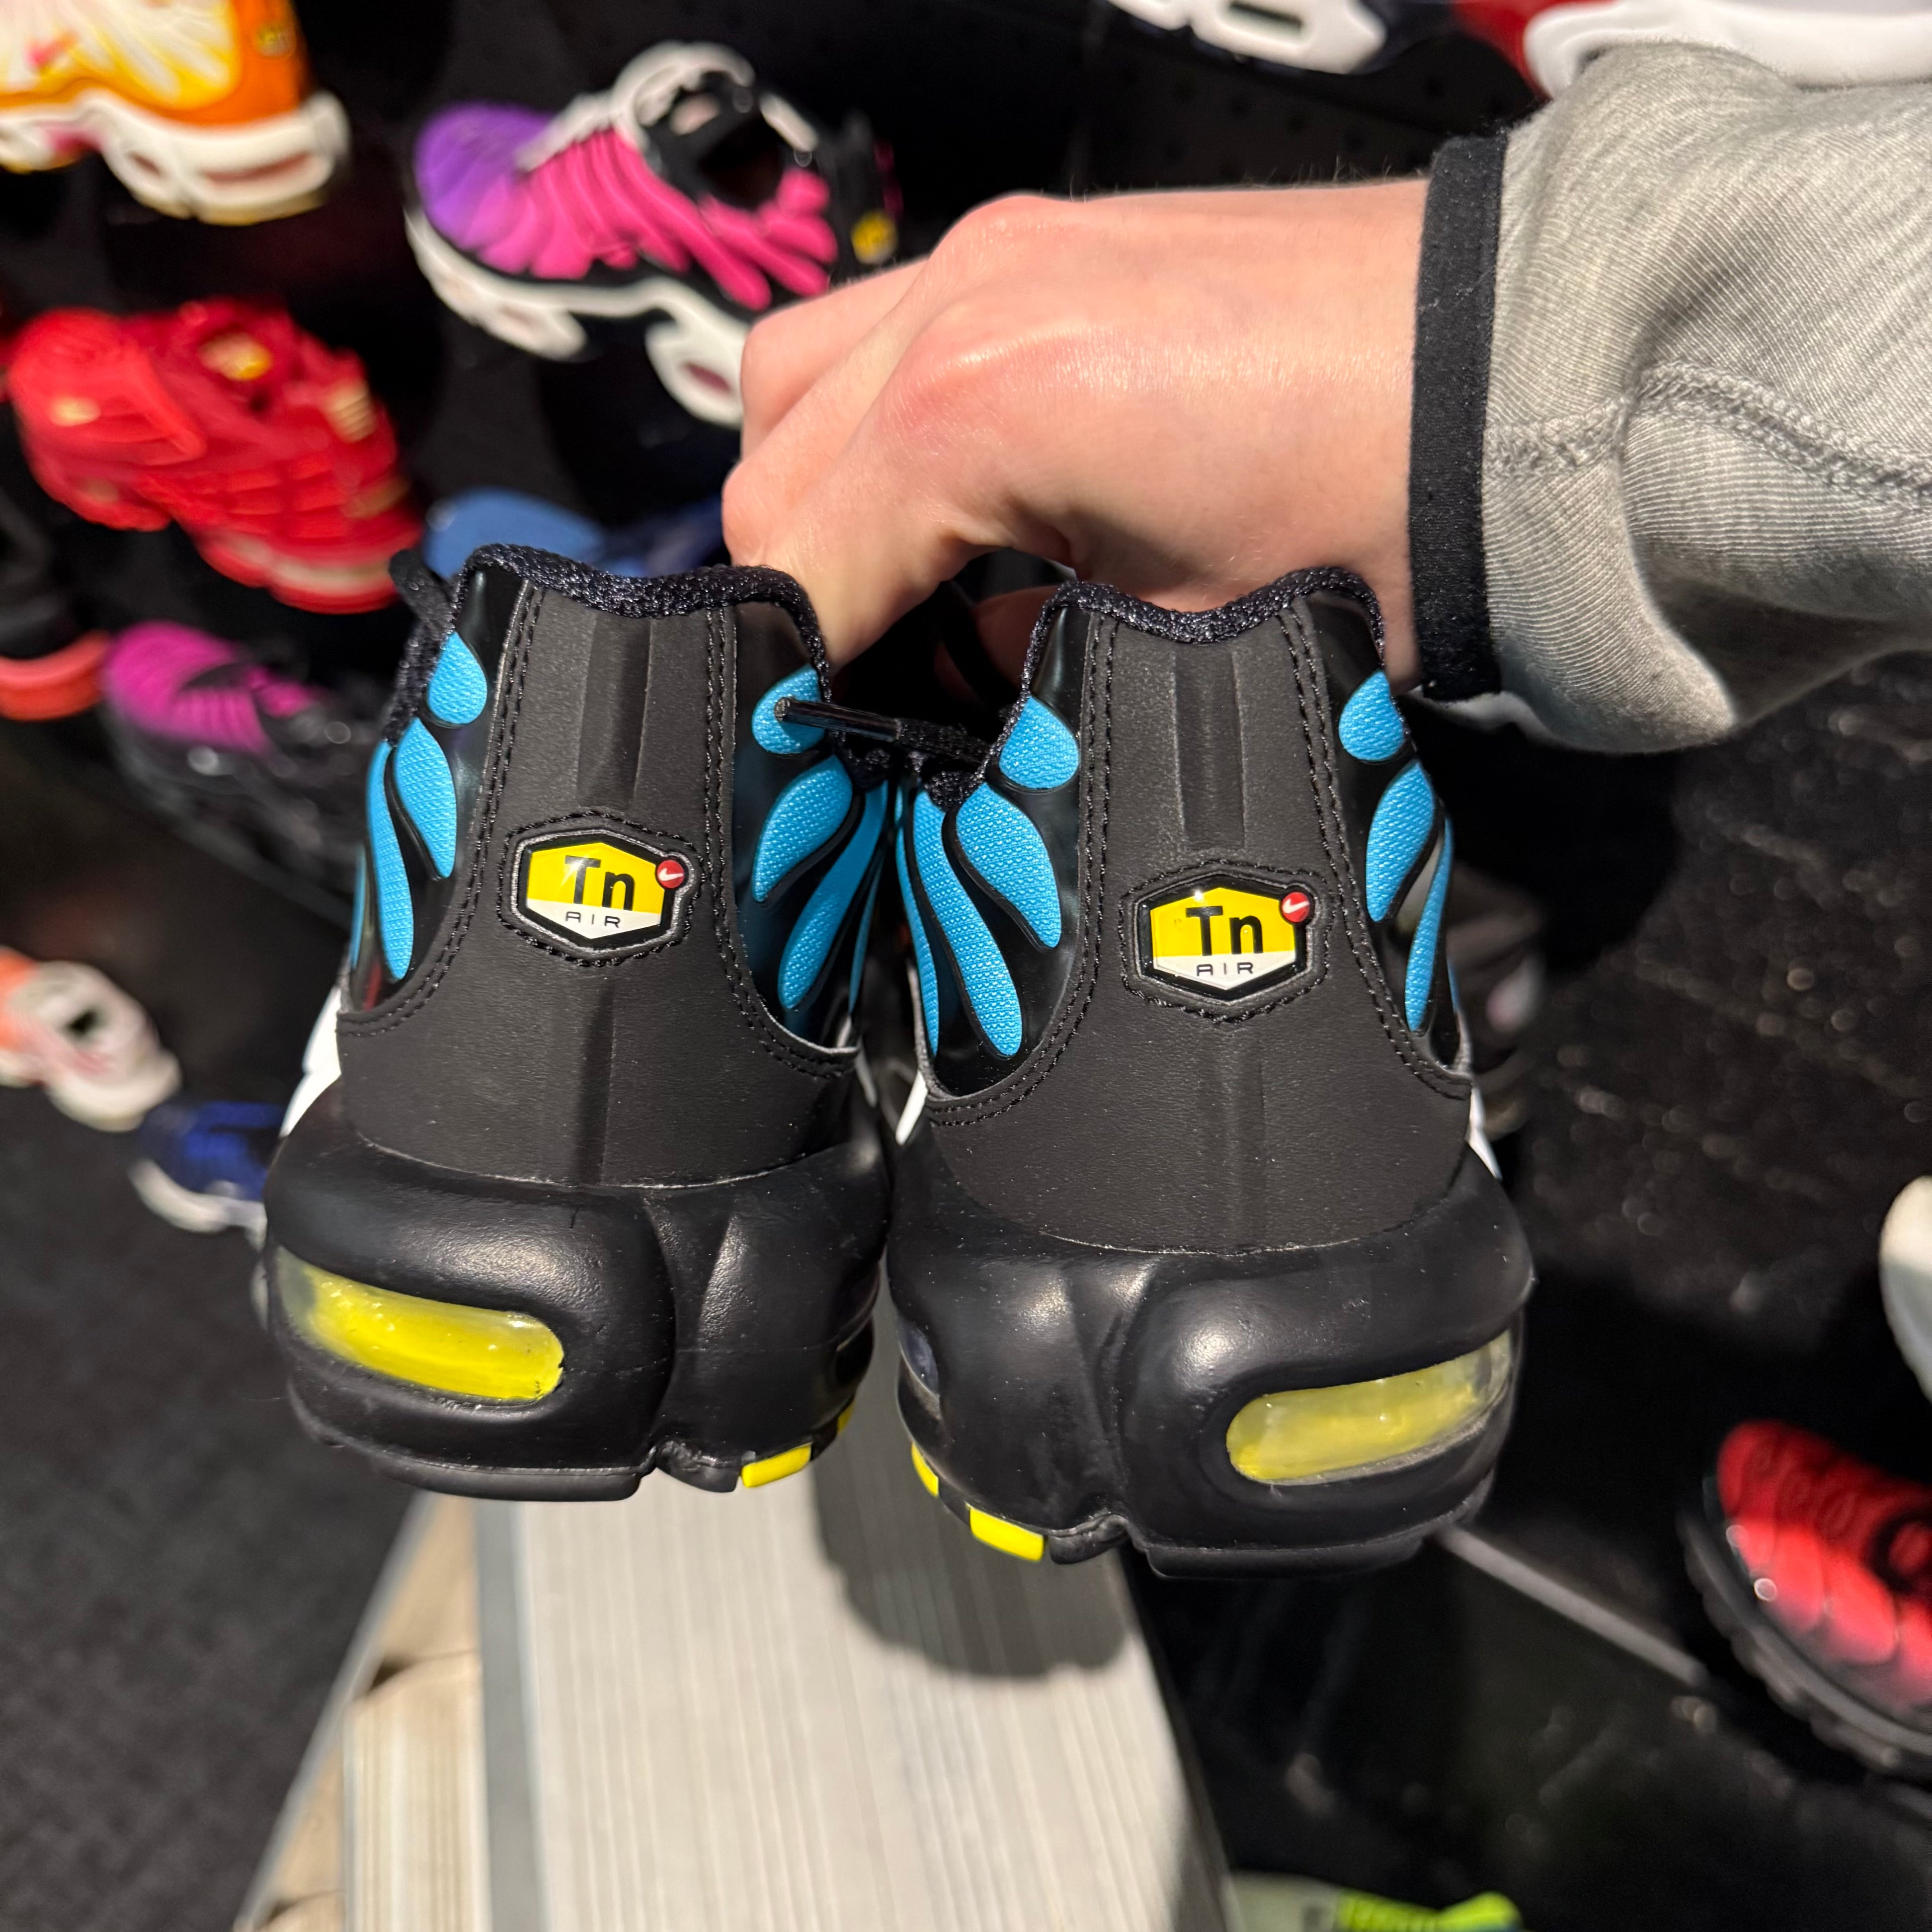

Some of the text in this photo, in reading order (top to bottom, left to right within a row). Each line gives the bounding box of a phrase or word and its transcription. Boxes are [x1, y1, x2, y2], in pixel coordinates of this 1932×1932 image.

[565, 855, 635, 911] Tn
[565, 911, 621, 928] AIR
[1185, 906, 1264, 956] Tn
[1196, 961, 1254, 977] AIR
